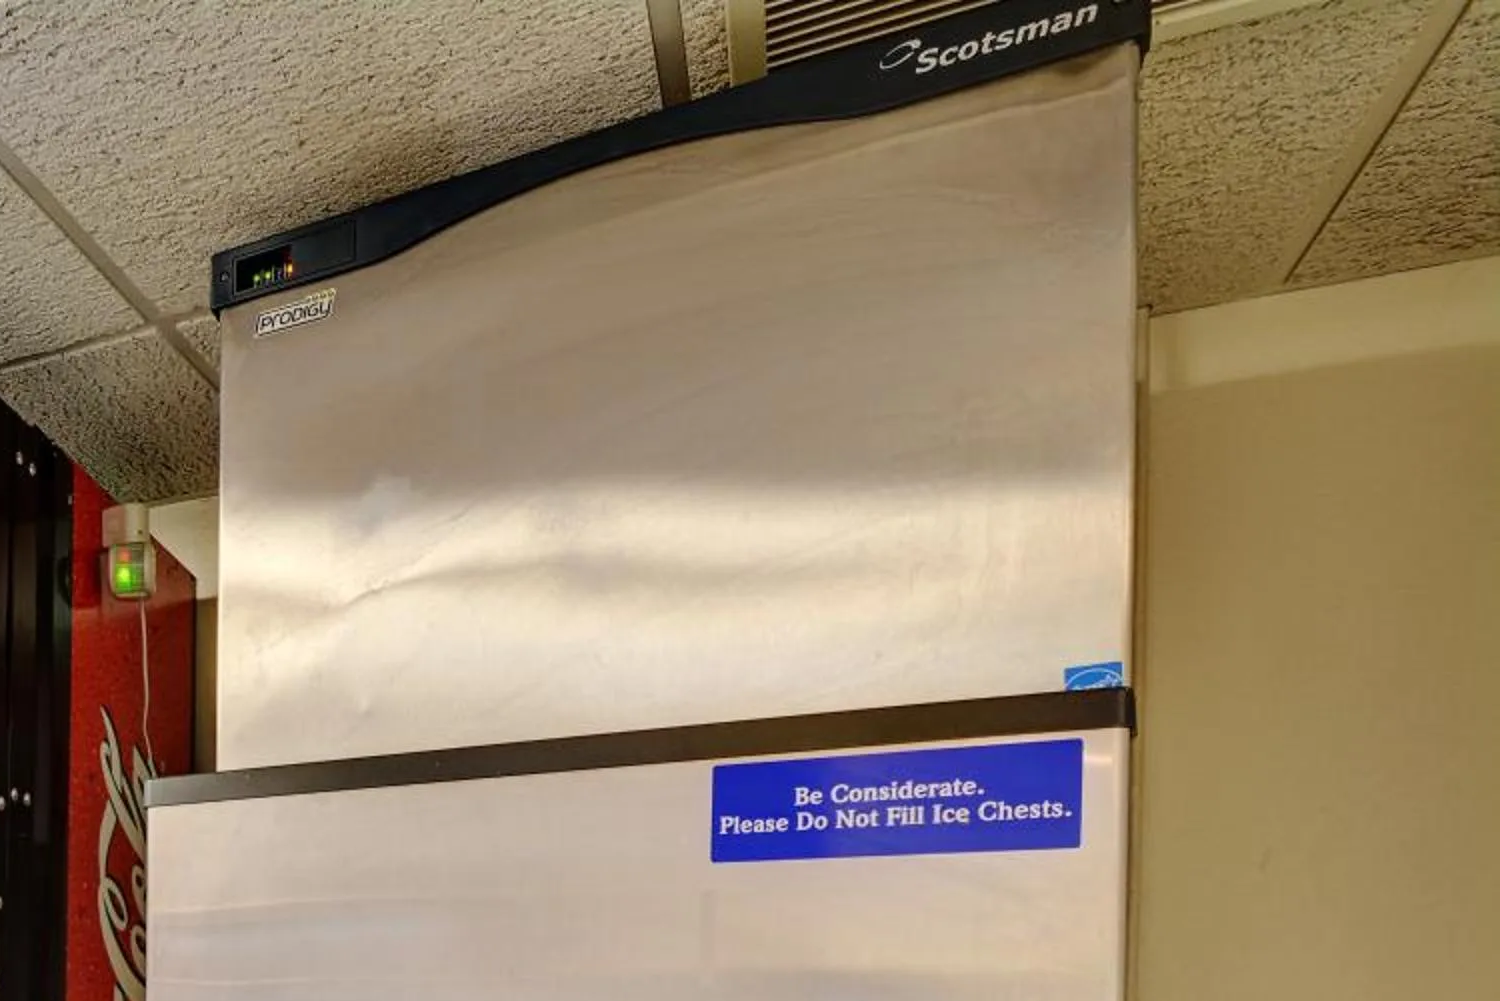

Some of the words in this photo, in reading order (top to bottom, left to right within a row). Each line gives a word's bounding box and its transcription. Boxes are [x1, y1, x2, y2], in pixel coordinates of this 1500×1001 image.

[915, 3, 1099, 74] Scotsman
[793, 786, 823, 807] Be
[831, 778, 986, 804] Considerate.
[719, 814, 789, 835] Please
[796, 811, 828, 831] Do
[835, 808, 880, 829] Not
[886, 805, 925, 827] Fill
[932, 803, 970, 825] Ice
[978, 800, 1073, 822] Chests.
